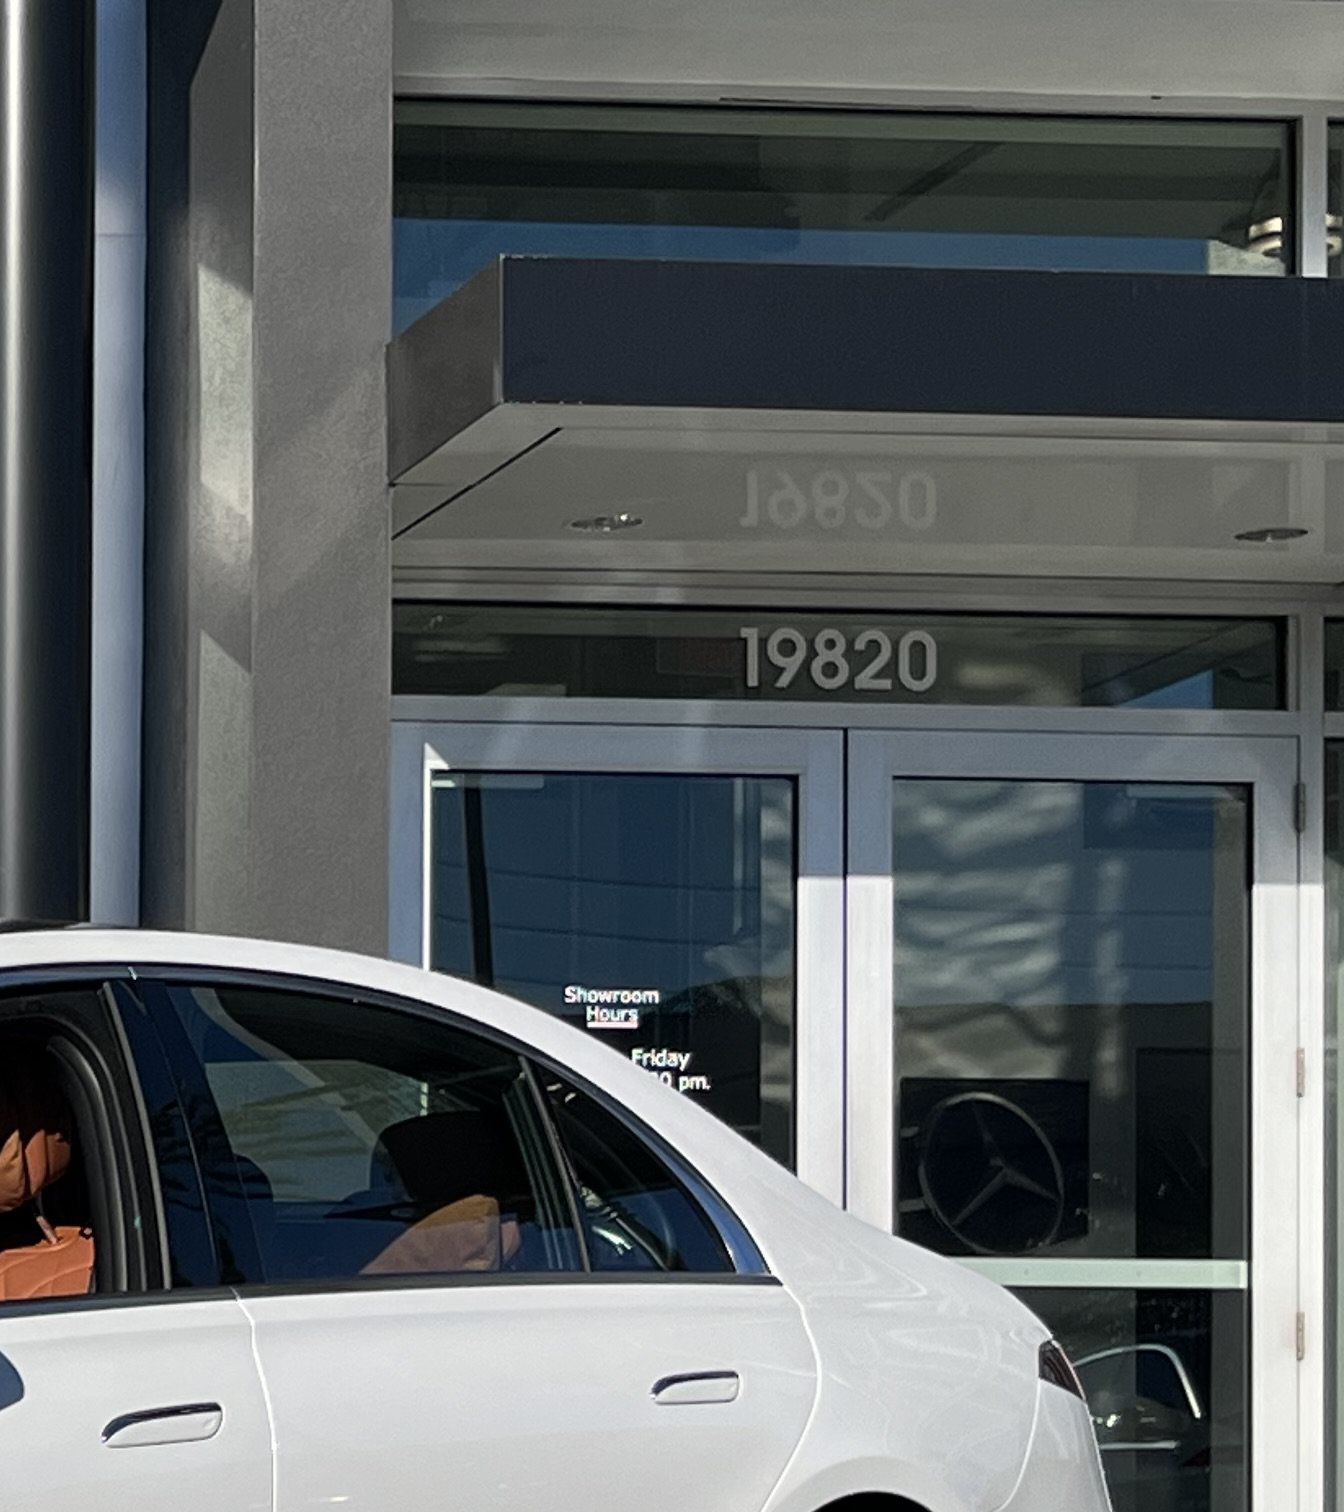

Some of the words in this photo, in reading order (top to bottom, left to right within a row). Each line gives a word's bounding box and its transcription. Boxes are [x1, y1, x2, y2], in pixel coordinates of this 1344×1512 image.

[740, 627, 937, 692] 19820
[564, 985, 660, 1004] Showroom
[586, 1005, 639, 1023] Hours
[631, 1048, 691, 1072] Friday
